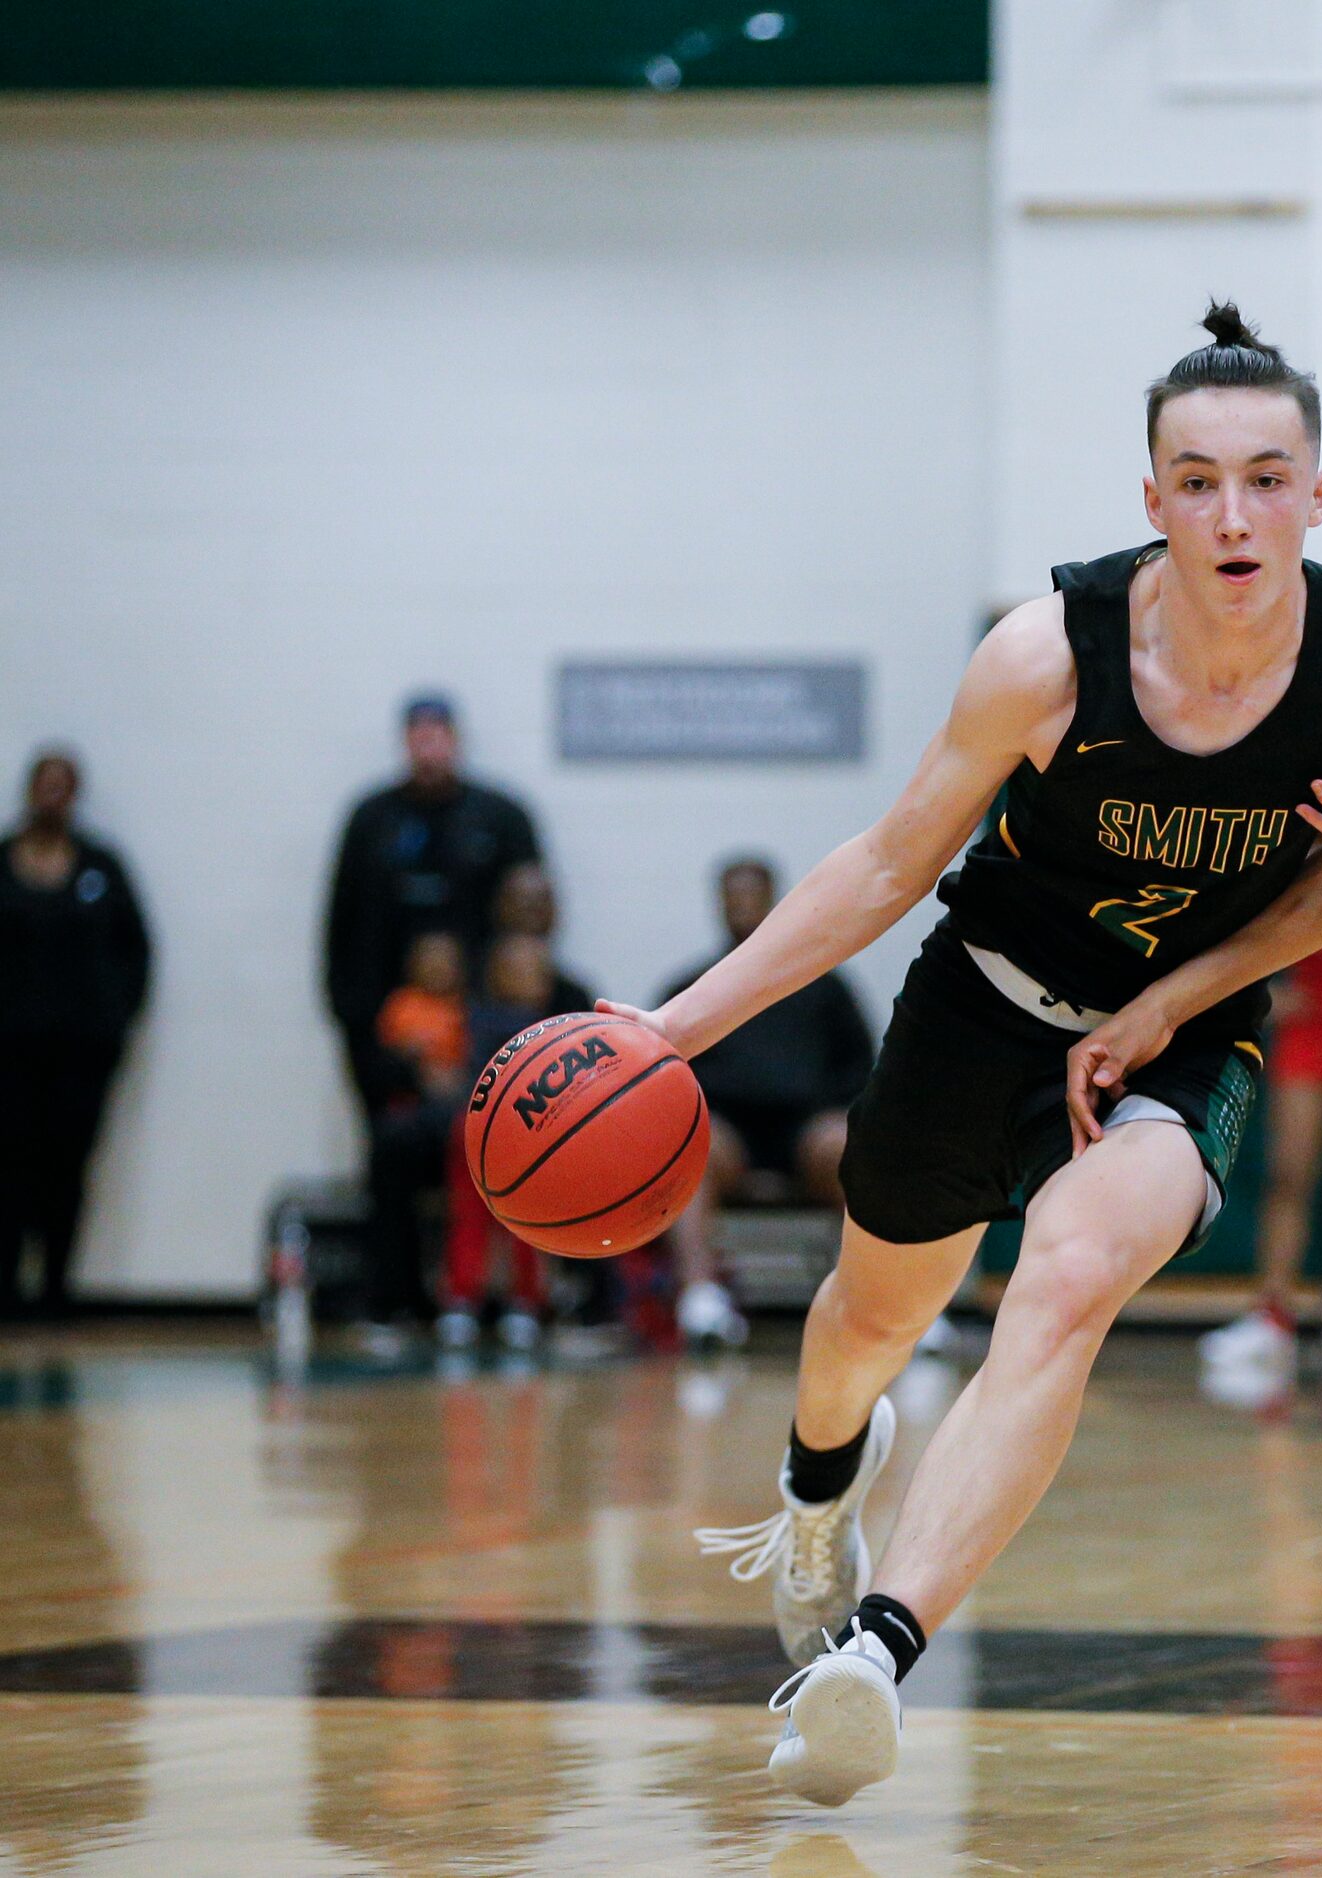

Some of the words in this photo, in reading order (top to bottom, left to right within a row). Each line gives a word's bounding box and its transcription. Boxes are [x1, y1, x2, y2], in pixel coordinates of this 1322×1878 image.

[1098, 799, 1289, 874] SMITH
[1088, 883, 1199, 959] 2
[512, 1034, 617, 1131] NCAA
